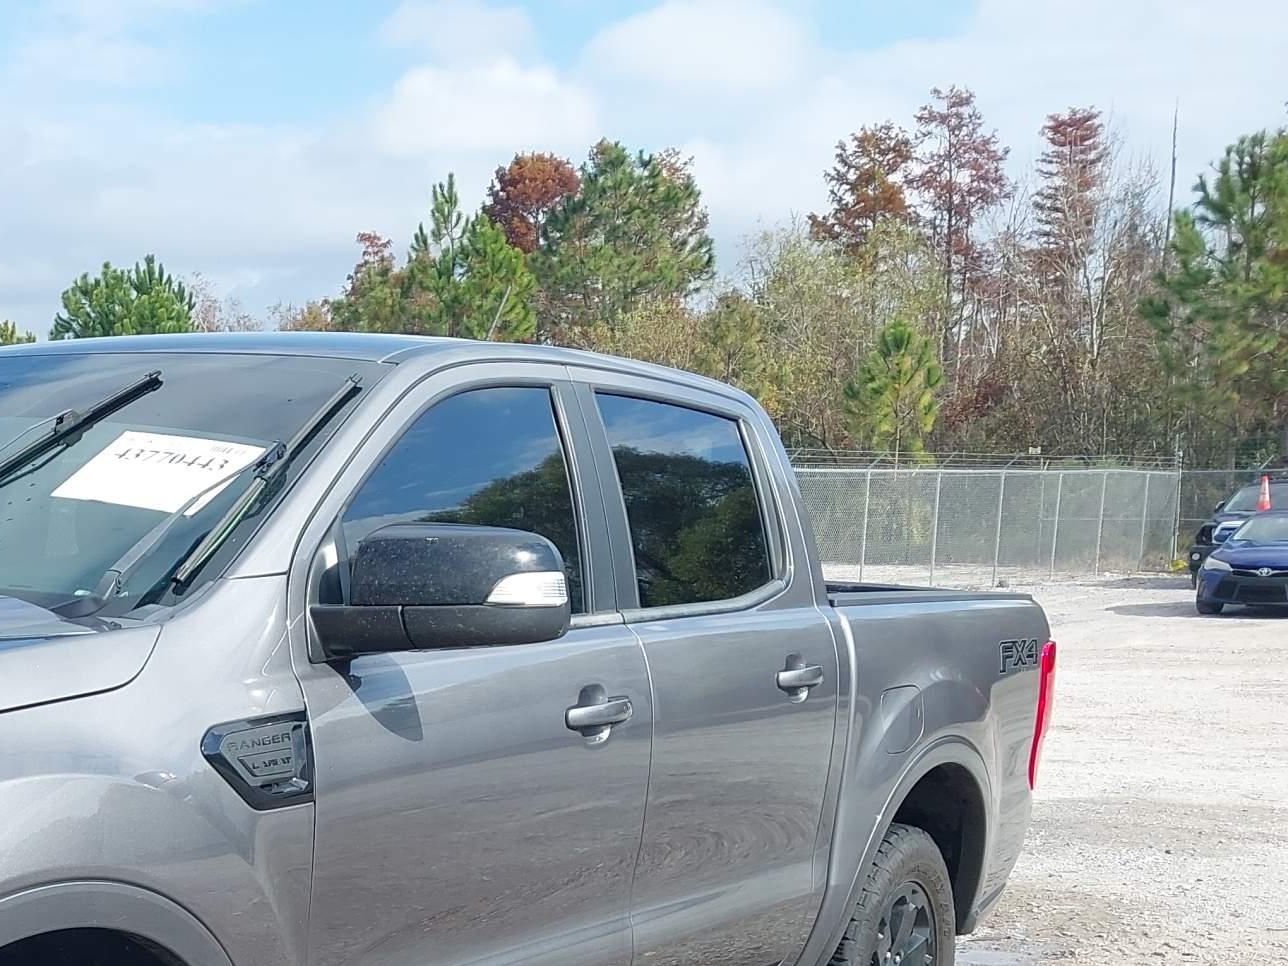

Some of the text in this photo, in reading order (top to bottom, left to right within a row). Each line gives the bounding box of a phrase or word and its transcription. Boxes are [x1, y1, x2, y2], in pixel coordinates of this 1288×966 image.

[115, 447, 229, 470] 43770443
[999, 638, 1039, 675] FX4
[228, 733, 291, 751] RANGER
